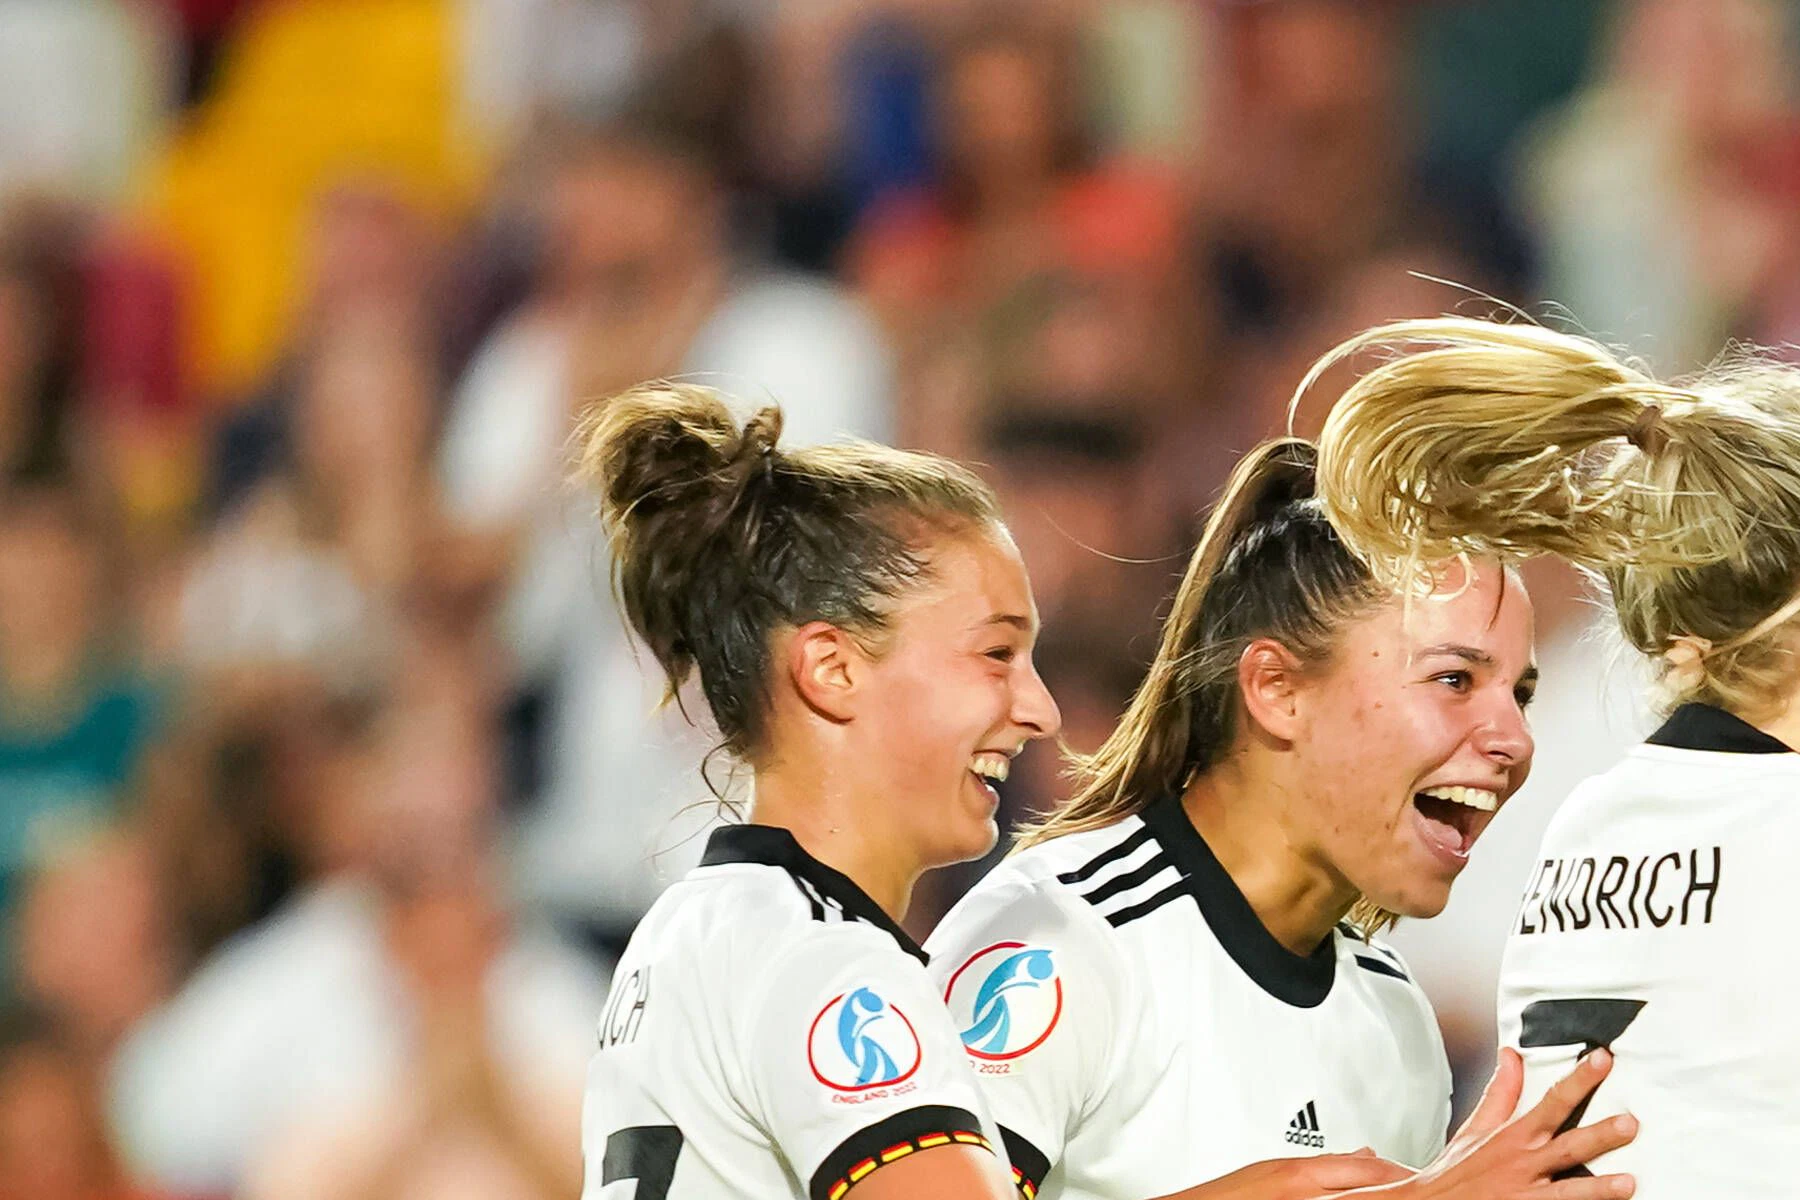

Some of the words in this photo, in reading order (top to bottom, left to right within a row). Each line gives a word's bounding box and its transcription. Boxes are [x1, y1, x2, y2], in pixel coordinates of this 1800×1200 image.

[1510, 846, 1721, 936] ENDRICH
[979, 1063, 1010, 1074] 2022
[1284, 1128, 1325, 1149] adidas
